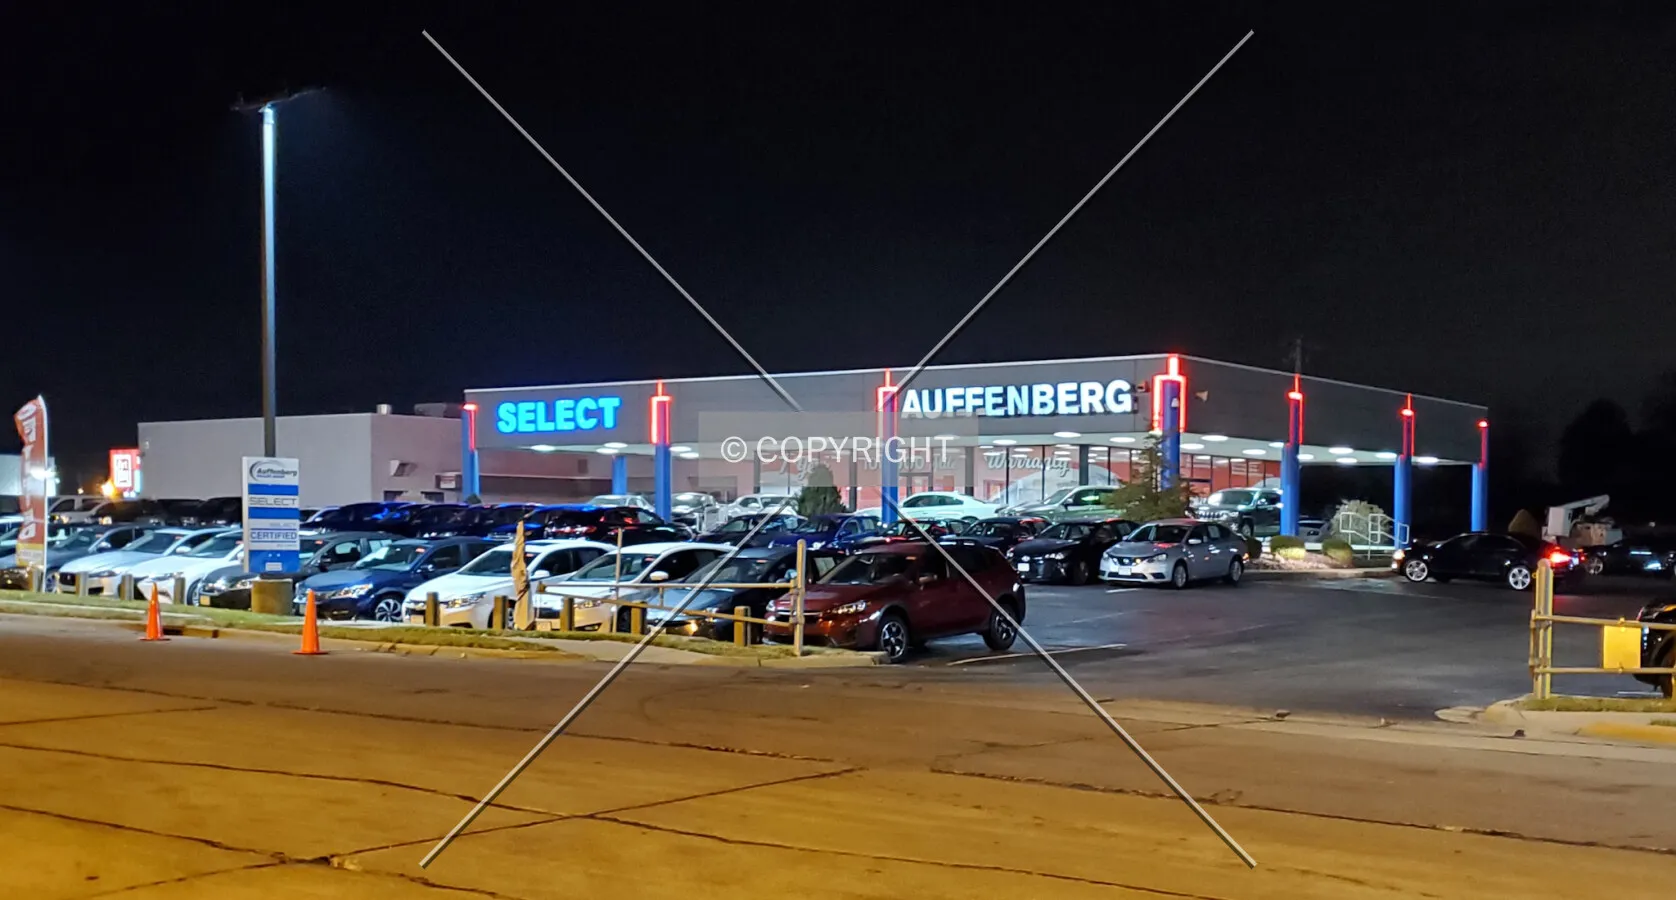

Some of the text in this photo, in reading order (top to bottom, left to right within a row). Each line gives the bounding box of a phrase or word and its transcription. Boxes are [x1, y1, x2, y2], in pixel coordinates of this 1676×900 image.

[901, 379, 1133, 419] AUFFENBERG
[496, 396, 621, 434] SELECT
[984, 450, 1071, 478] Warranty
[249, 497, 297, 506] SELECT
[250, 531, 298, 540] CERTIFIED
